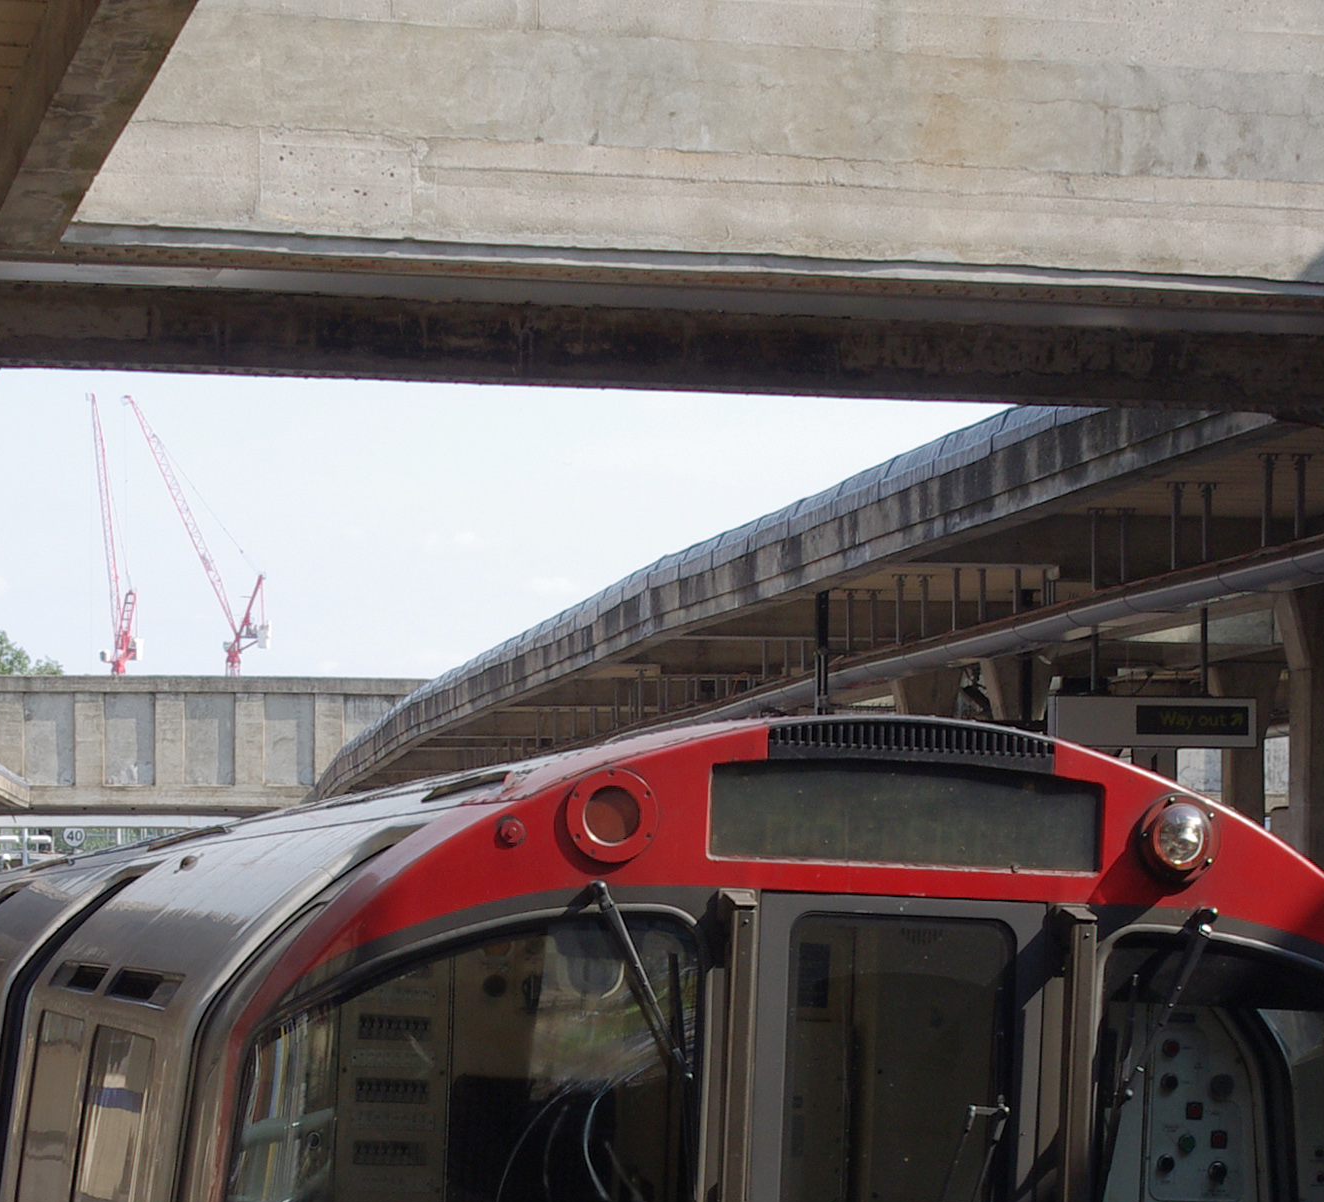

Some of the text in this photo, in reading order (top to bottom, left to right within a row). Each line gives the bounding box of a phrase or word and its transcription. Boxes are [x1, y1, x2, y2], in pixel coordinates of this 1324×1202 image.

[1159, 711, 1227, 730] Way out
[67, 830, 83, 842] 40
